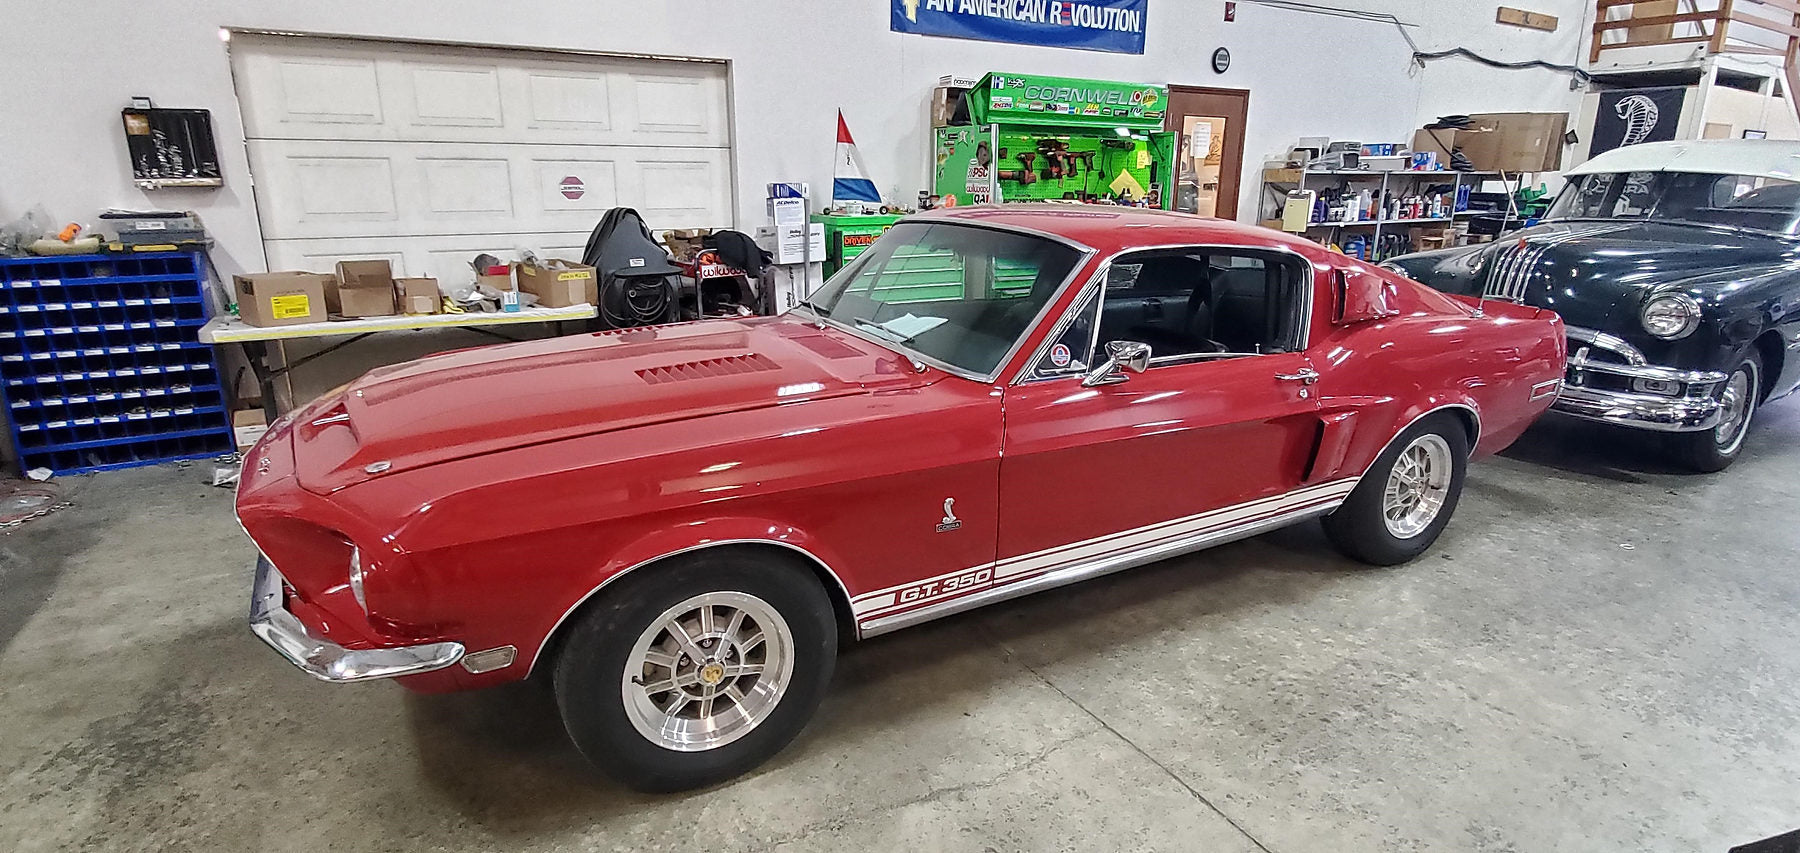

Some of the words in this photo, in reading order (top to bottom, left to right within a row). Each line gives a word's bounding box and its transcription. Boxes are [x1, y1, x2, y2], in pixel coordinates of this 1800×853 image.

[958, 0, 1047, 23] AMERICAN
[1024, 85, 1140, 106] CORNWELL
[942, 568, 992, 592] 350
